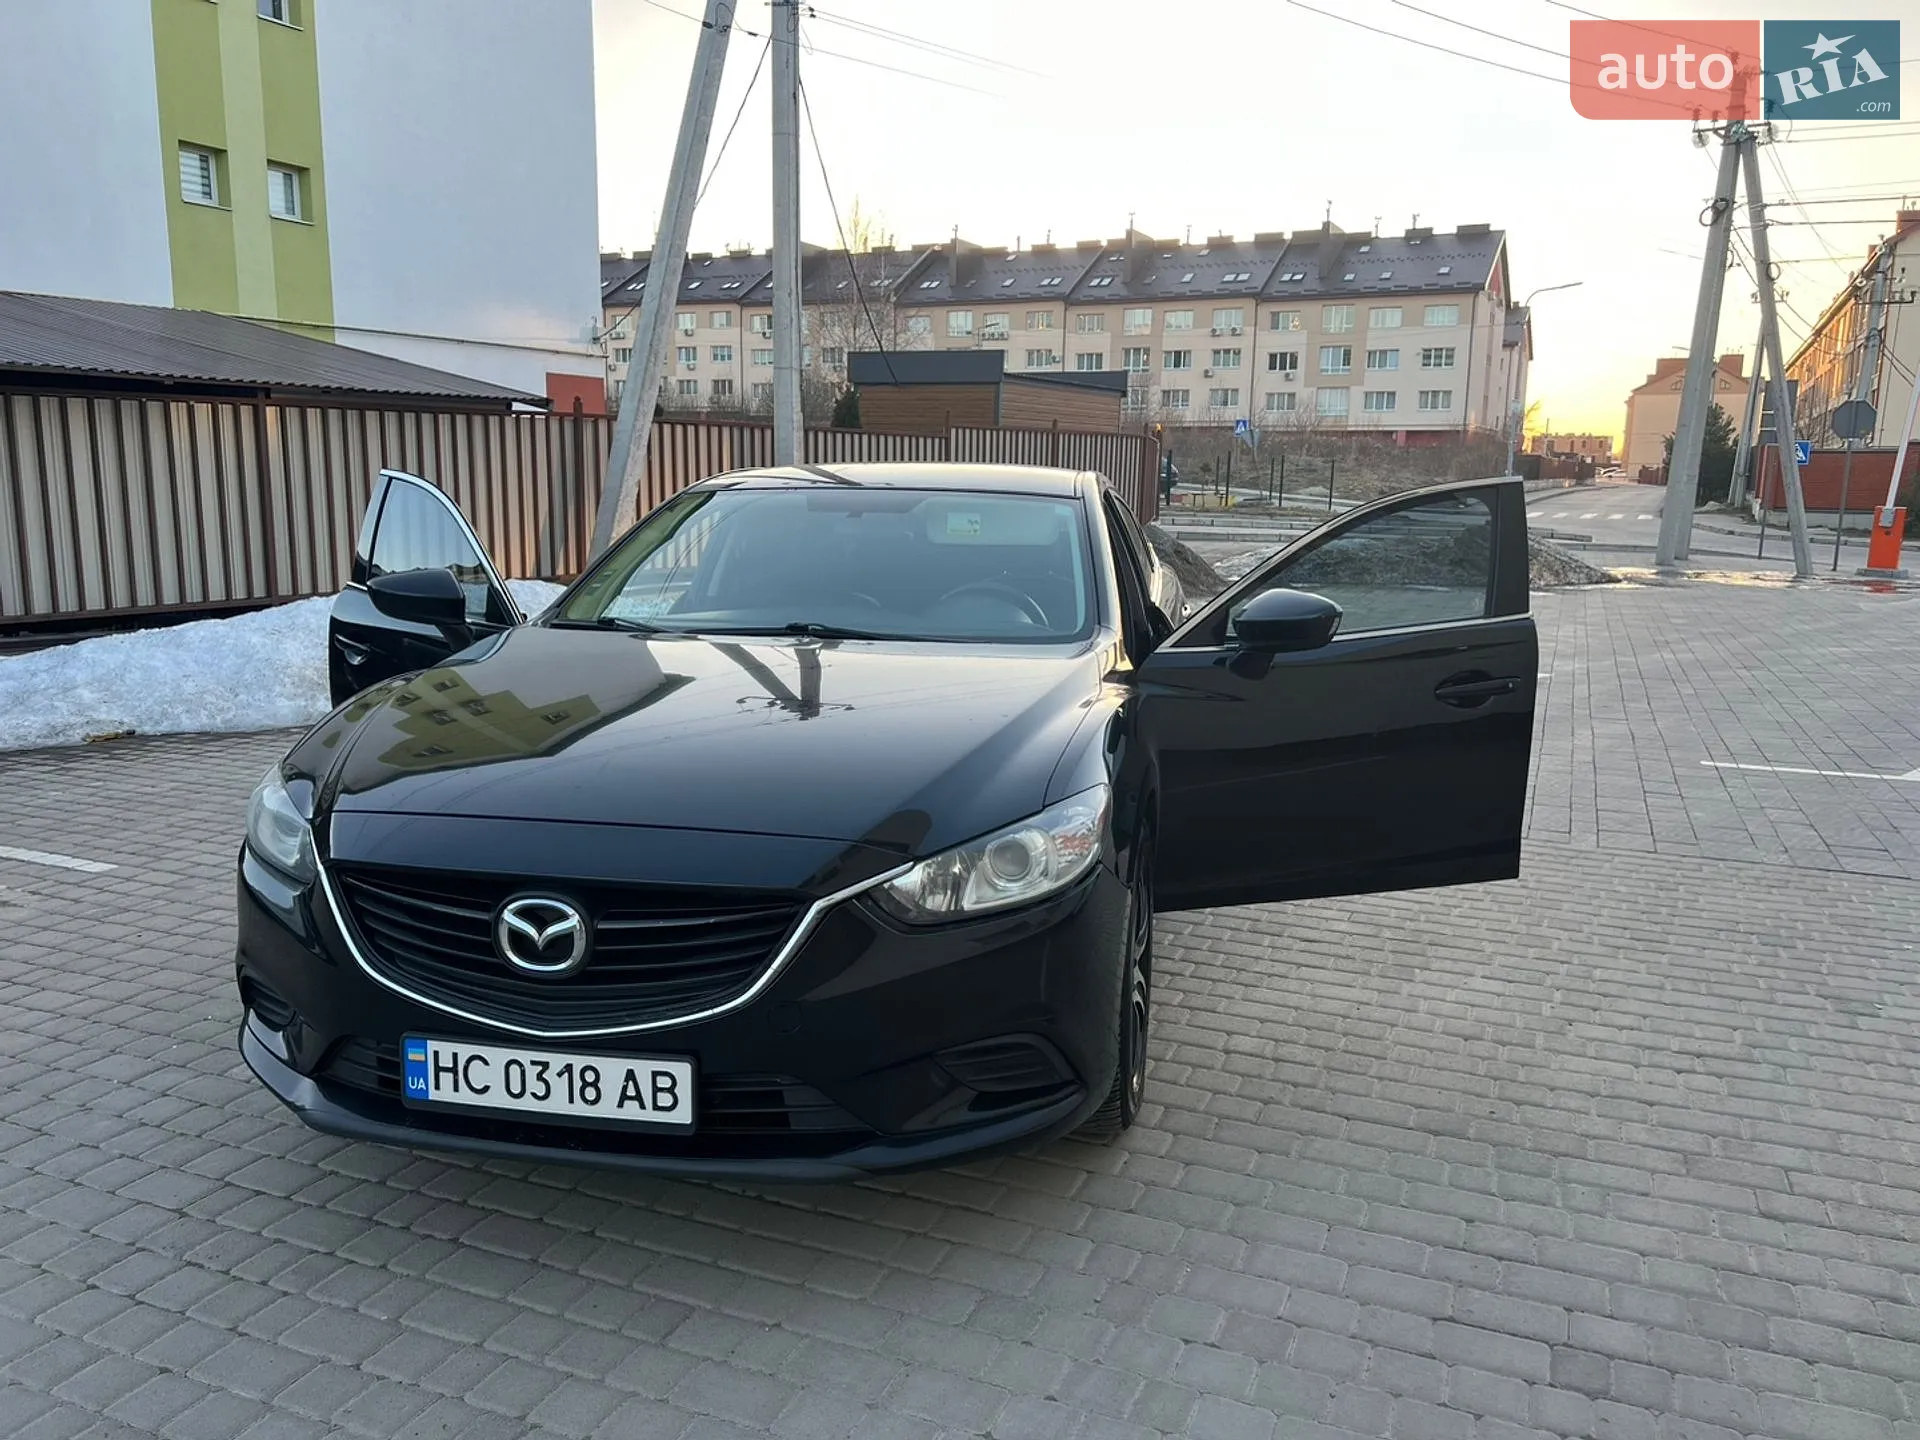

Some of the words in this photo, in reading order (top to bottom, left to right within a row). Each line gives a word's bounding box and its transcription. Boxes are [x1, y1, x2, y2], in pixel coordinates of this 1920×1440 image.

[408, 1076, 427, 1090] UA
[433, 1050, 491, 1095] HC
[504, 1058, 602, 1106] 0318
[616, 1068, 680, 1112] AB
